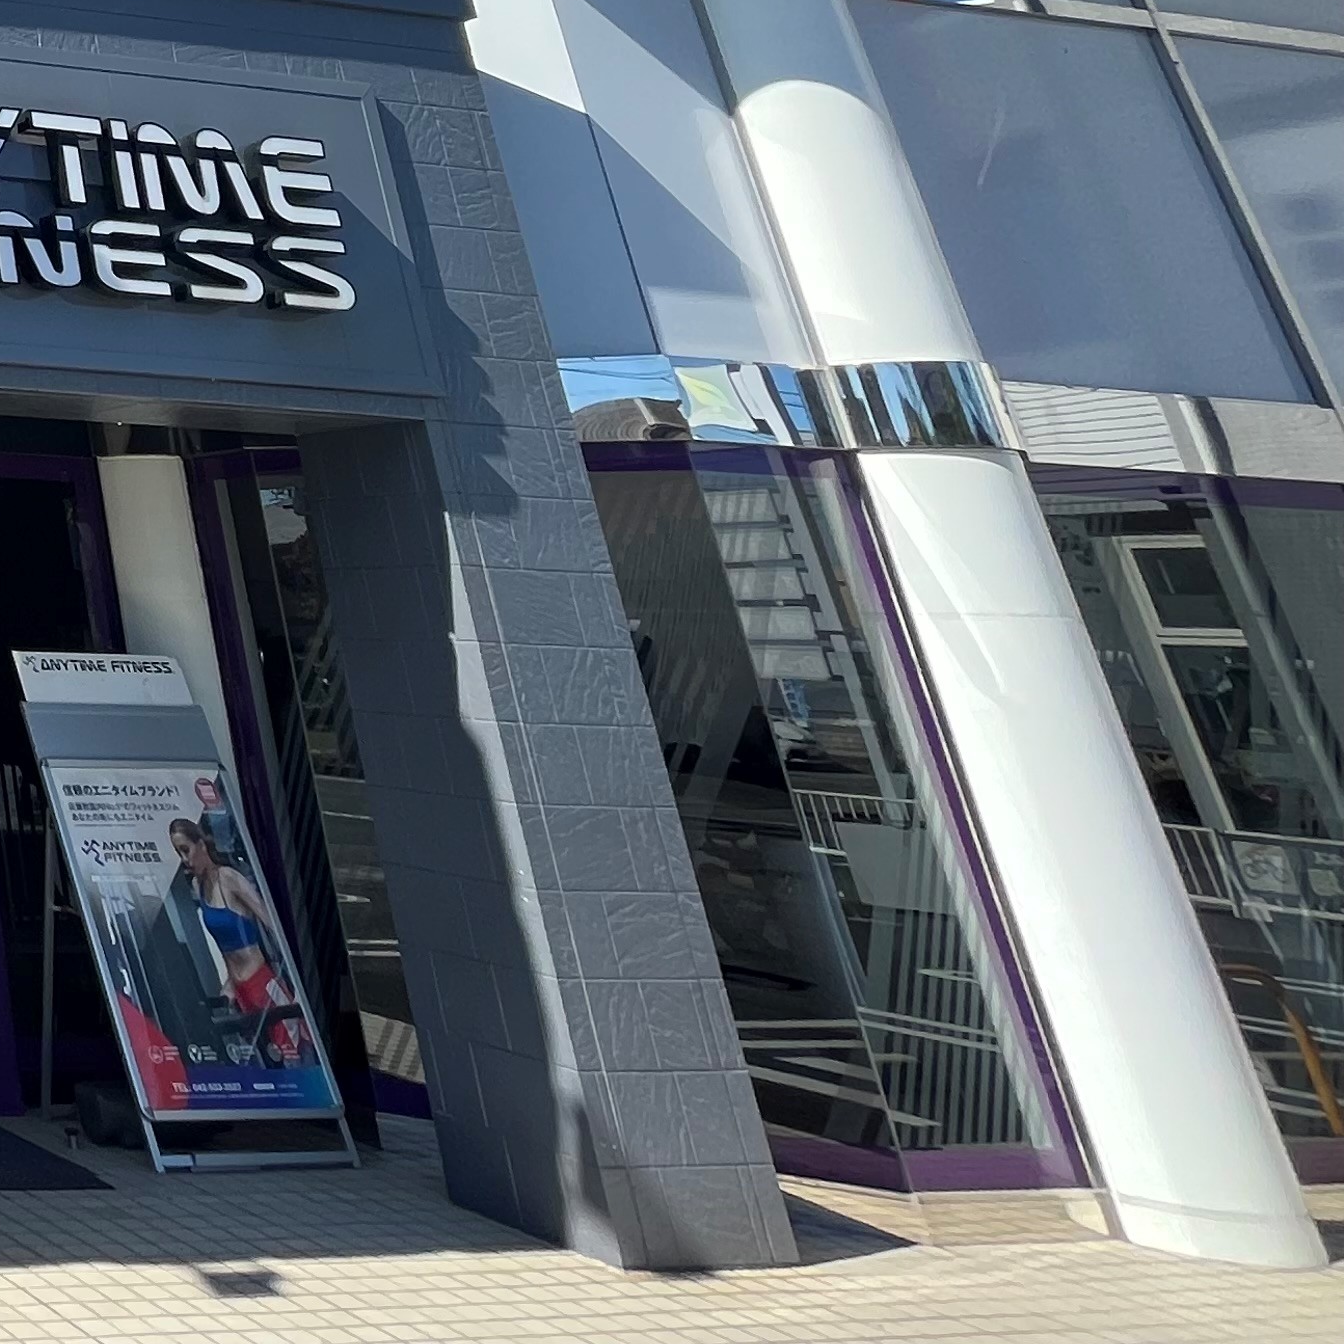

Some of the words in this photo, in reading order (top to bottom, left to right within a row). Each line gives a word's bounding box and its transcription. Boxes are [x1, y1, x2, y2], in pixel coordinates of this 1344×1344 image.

[41, 657, 107, 672] ANYTIME
[111, 659, 174, 674] FITNESS
[102, 841, 158, 851] ANYTIME
[104, 852, 162, 863] FITNESS
